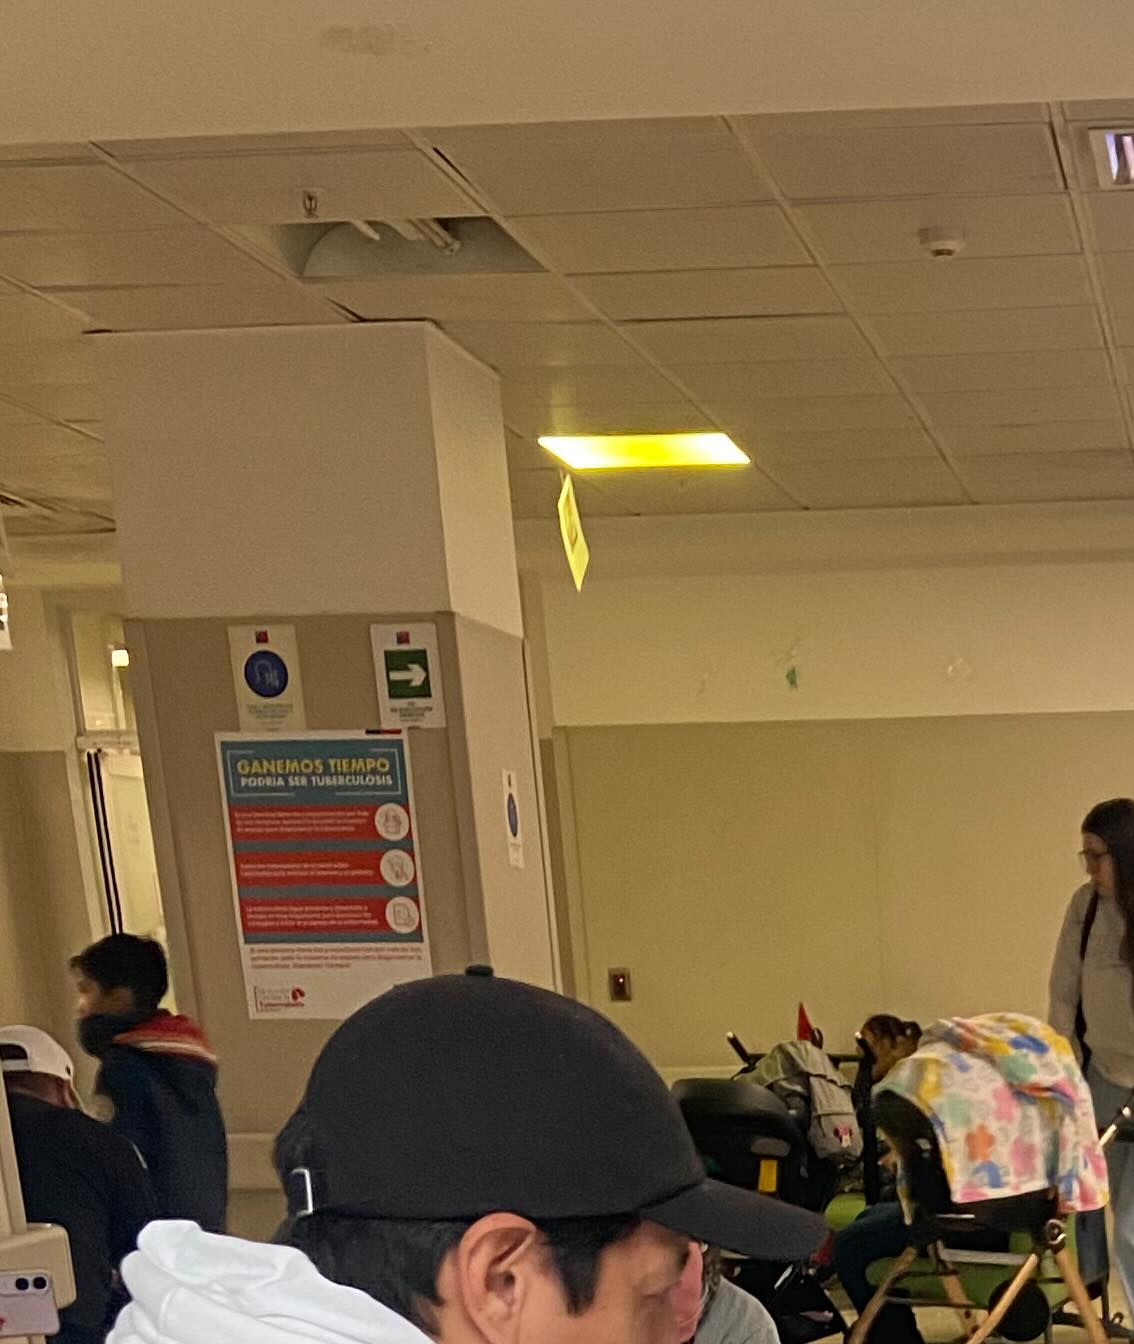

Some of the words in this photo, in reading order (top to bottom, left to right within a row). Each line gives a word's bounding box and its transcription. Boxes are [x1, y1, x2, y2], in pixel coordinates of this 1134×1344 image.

[237, 759, 324, 774] GANEMOS
[328, 758, 390, 773] TIEMPO
[288, 775, 308, 787] SER
[312, 774, 393, 786] TUBERCULOSIS
